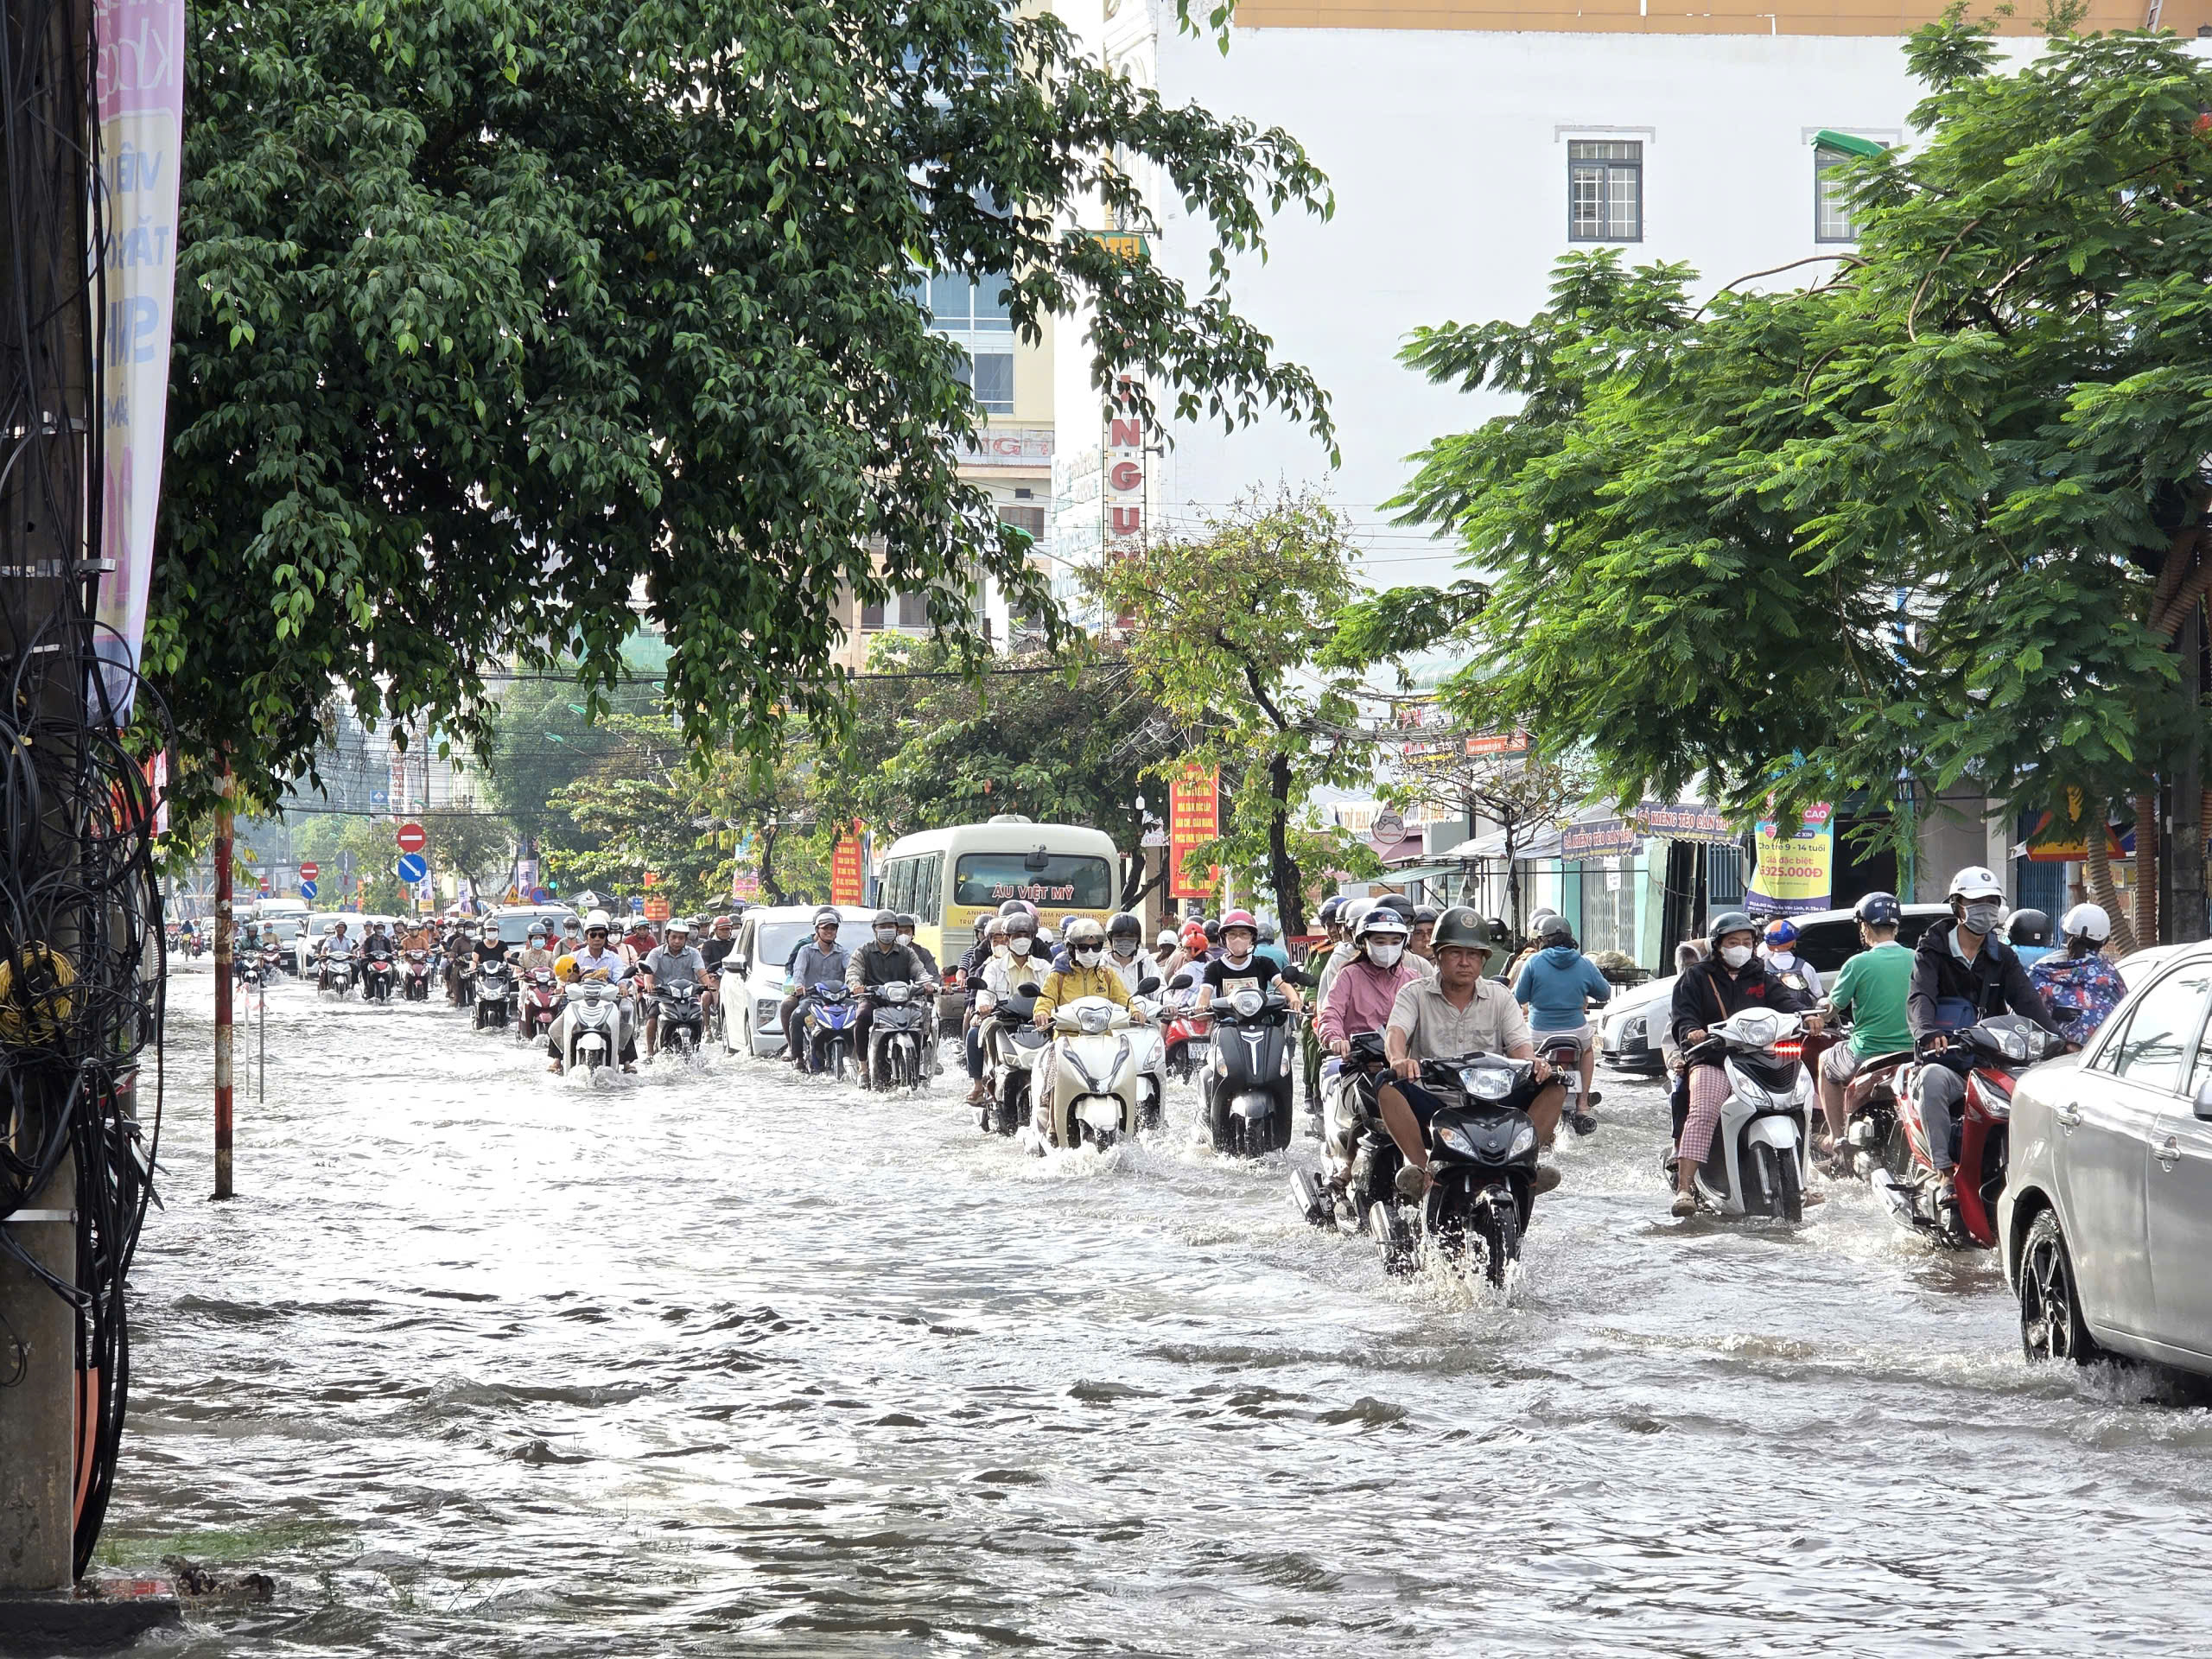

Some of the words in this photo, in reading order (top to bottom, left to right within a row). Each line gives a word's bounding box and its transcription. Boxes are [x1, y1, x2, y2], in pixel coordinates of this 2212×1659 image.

[1804, 810, 1827, 818] CAO
[1808, 842, 1826, 852] tuổi
[1779, 856, 1794, 865] đặc
[1796, 856, 1814, 866] biệt:
[992, 882, 1014, 898] ÂU
[1018, 883, 1048, 902] VIỆT
[1052, 885, 1074, 900] MỸ
